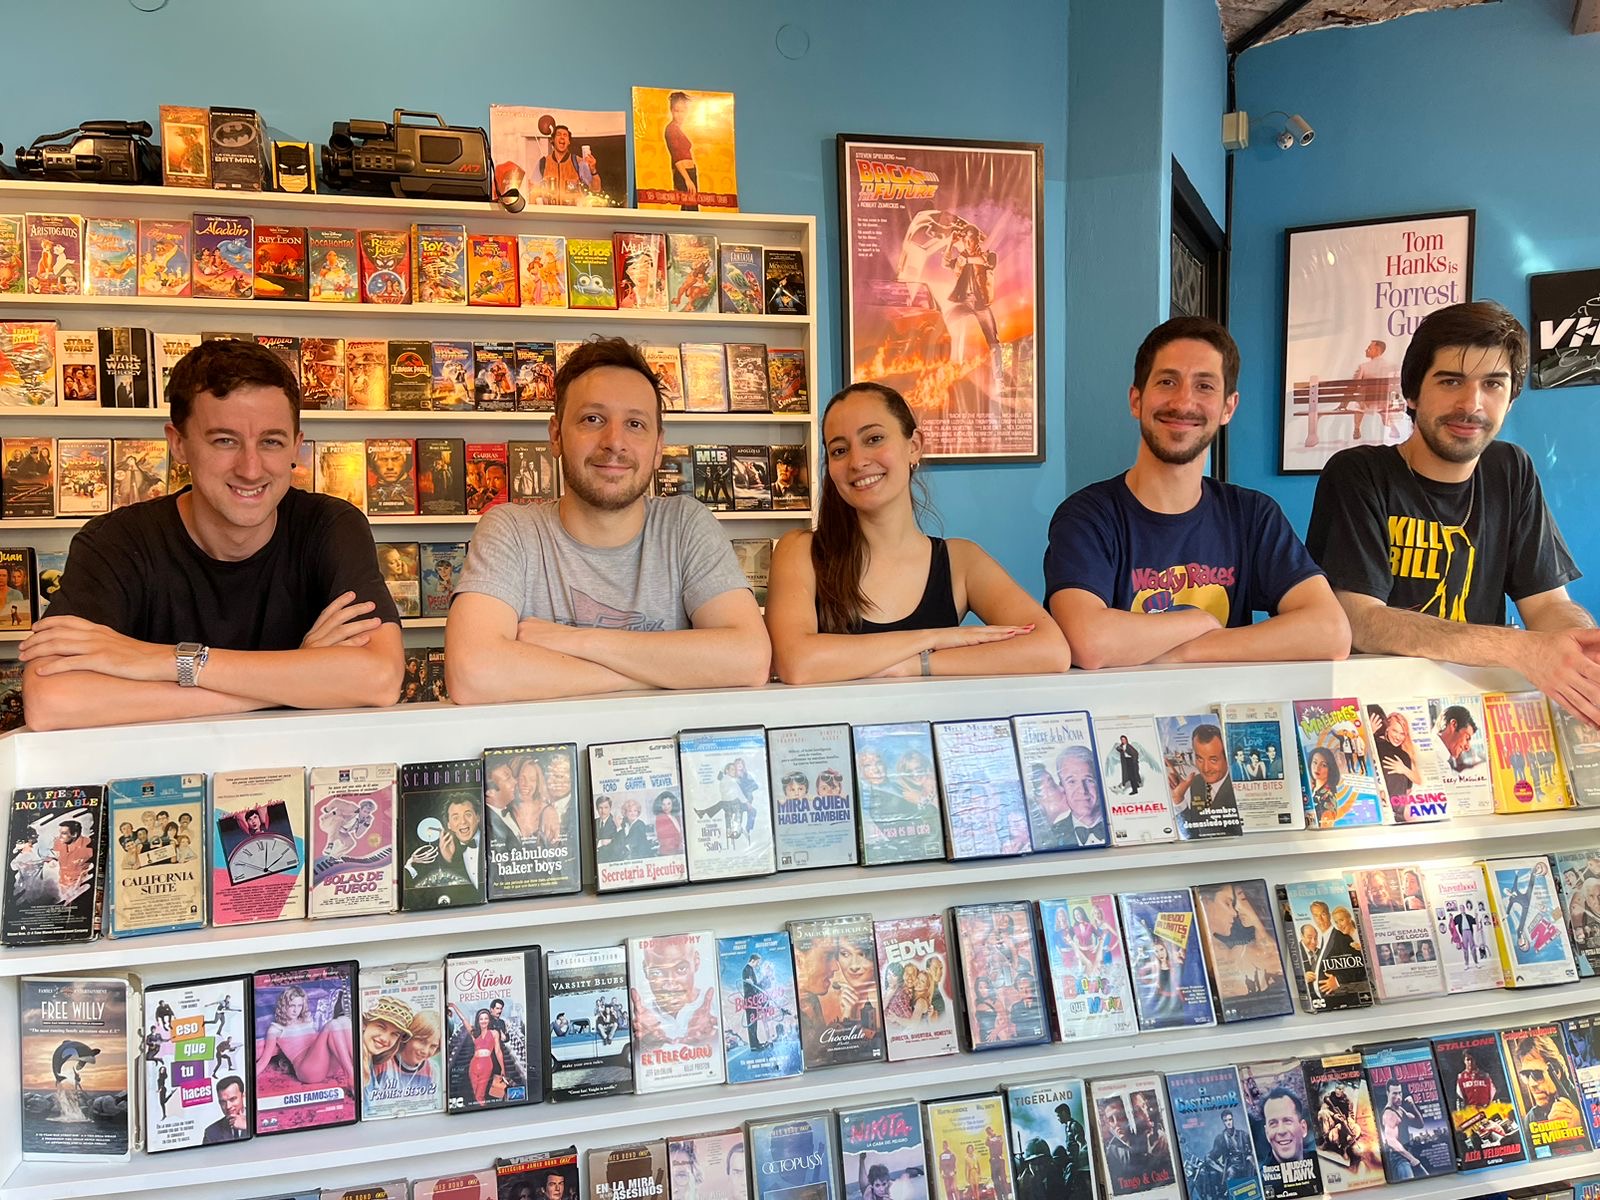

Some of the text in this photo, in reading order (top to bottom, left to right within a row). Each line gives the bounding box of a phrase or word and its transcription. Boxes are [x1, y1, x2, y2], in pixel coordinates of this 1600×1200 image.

[459, 164, 480, 172] M7
[856, 160, 938, 183] BACK
[861, 183, 874, 192] TO
[873, 184, 938, 200] FUTURE
[30, 224, 78, 238] ARISTOGATOS
[196, 221, 249, 236] Aladdin
[258, 236, 301, 244] REY LEON
[310, 237, 354, 248] POCAHONTAS
[423, 242, 443, 252] TOY
[1403, 231, 1443, 252] Tom
[373, 246, 398, 257] JAFAR
[730, 252, 753, 263] FANTASIA
[1386, 253, 1458, 276] Hanks is
[1375, 280, 1459, 309] Forrest
[1388, 310, 1426, 337] Gu
[258, 337, 293, 349] RAIDERS
[106, 361, 141, 370] WARS
[1388, 516, 1443, 550] KILL
[1390, 546, 1440, 579] BILL
[1132, 563, 1235, 594] Wacky Races
[1301, 705, 1357, 739] MALLRATS
[1487, 702, 1549, 732] THE FULL
[1243, 736, 1262, 747] Love
[1494, 731, 1554, 770] MONTY
[404, 770, 481, 787] SCROOGED
[603, 784, 617, 792] FORD
[651, 778, 672, 787] WEAVER
[1233, 781, 1283, 791] REALITY BITES
[27, 789, 86, 800] LA FIESTA
[1391, 792, 1447, 806] CHASING
[15, 798, 98, 811] INOLVIDABLE
[778, 794, 850, 814] MIRA QUIEN
[1112, 803, 1167, 814] MICHAEL
[1410, 803, 1447, 817] AMY
[778, 810, 850, 826] HABLA TAMBIEN
[1184, 819, 1240, 828] demasiado poco
[491, 846, 568, 862] los fabulosos
[498, 860, 562, 875] baker boys
[601, 861, 685, 883] Secretaria Ejecutiva
[122, 872, 194, 887] CALIFORNIA
[324, 871, 384, 886] BOLAS DE
[140, 883, 176, 895] SUITE
[334, 883, 377, 895] FUEGO
[1438, 881, 1478, 894] Parenthood
[796, 927, 802, 938] 5
[885, 939, 935, 962] EDtv
[1286, 929, 1300, 967] JUNIOR
[1322, 956, 1363, 971] JUNIOR
[454, 968, 512, 991] Niñera
[552, 976, 624, 991] VARSITY BLUES
[460, 989, 511, 1002] PRESIDENTE
[41, 1001, 104, 1020] FREE WILLY
[1070, 1002, 1085, 1012] QUE
[176, 1022, 198, 1036] eso
[820, 1025, 866, 1044] Chocolate
[1503, 1026, 1557, 1040] CHUCK NORRIS
[183, 1042, 206, 1057] que
[1437, 1038, 1495, 1052] STALLONE
[641, 1054, 653, 1066] EL
[181, 1066, 194, 1078] tu
[1371, 1061, 1433, 1083] VAN DAMME
[384, 1079, 397, 1089] MI
[1408, 1080, 1436, 1093] CORAZON
[182, 1085, 212, 1101] haces
[284, 1089, 339, 1105] CASI FAMOSOS
[370, 1087, 402, 1100] PRIMER
[404, 1085, 425, 1097] BESO
[1014, 1090, 1073, 1106] TIGERLAND
[1413, 1091, 1439, 1103] DE LEON
[1175, 1092, 1238, 1112] CASTIGADOR
[851, 1112, 912, 1143] NIKITA
[1529, 1121, 1568, 1134] CODIGO
[1532, 1127, 1584, 1145] DE MUERTE
[1465, 1144, 1520, 1162] ALTA VELOCIDAD
[498, 1164, 526, 1174] COLECCION
[527, 1161, 542, 1170] JAMES
[762, 1152, 824, 1174] OCTOPUSSY
[1263, 1165, 1280, 1173] BRUCE
[1281, 1159, 1313, 1180] HUDSON
[1118, 1170, 1169, 1189] Tango & Cash
[1263, 1173, 1281, 1181] WILLIS
[1283, 1166, 1316, 1183] HAWK
[596, 1177, 654, 1194] EN LA MIRA
[612, 1184, 663, 1200] ASESINOS
